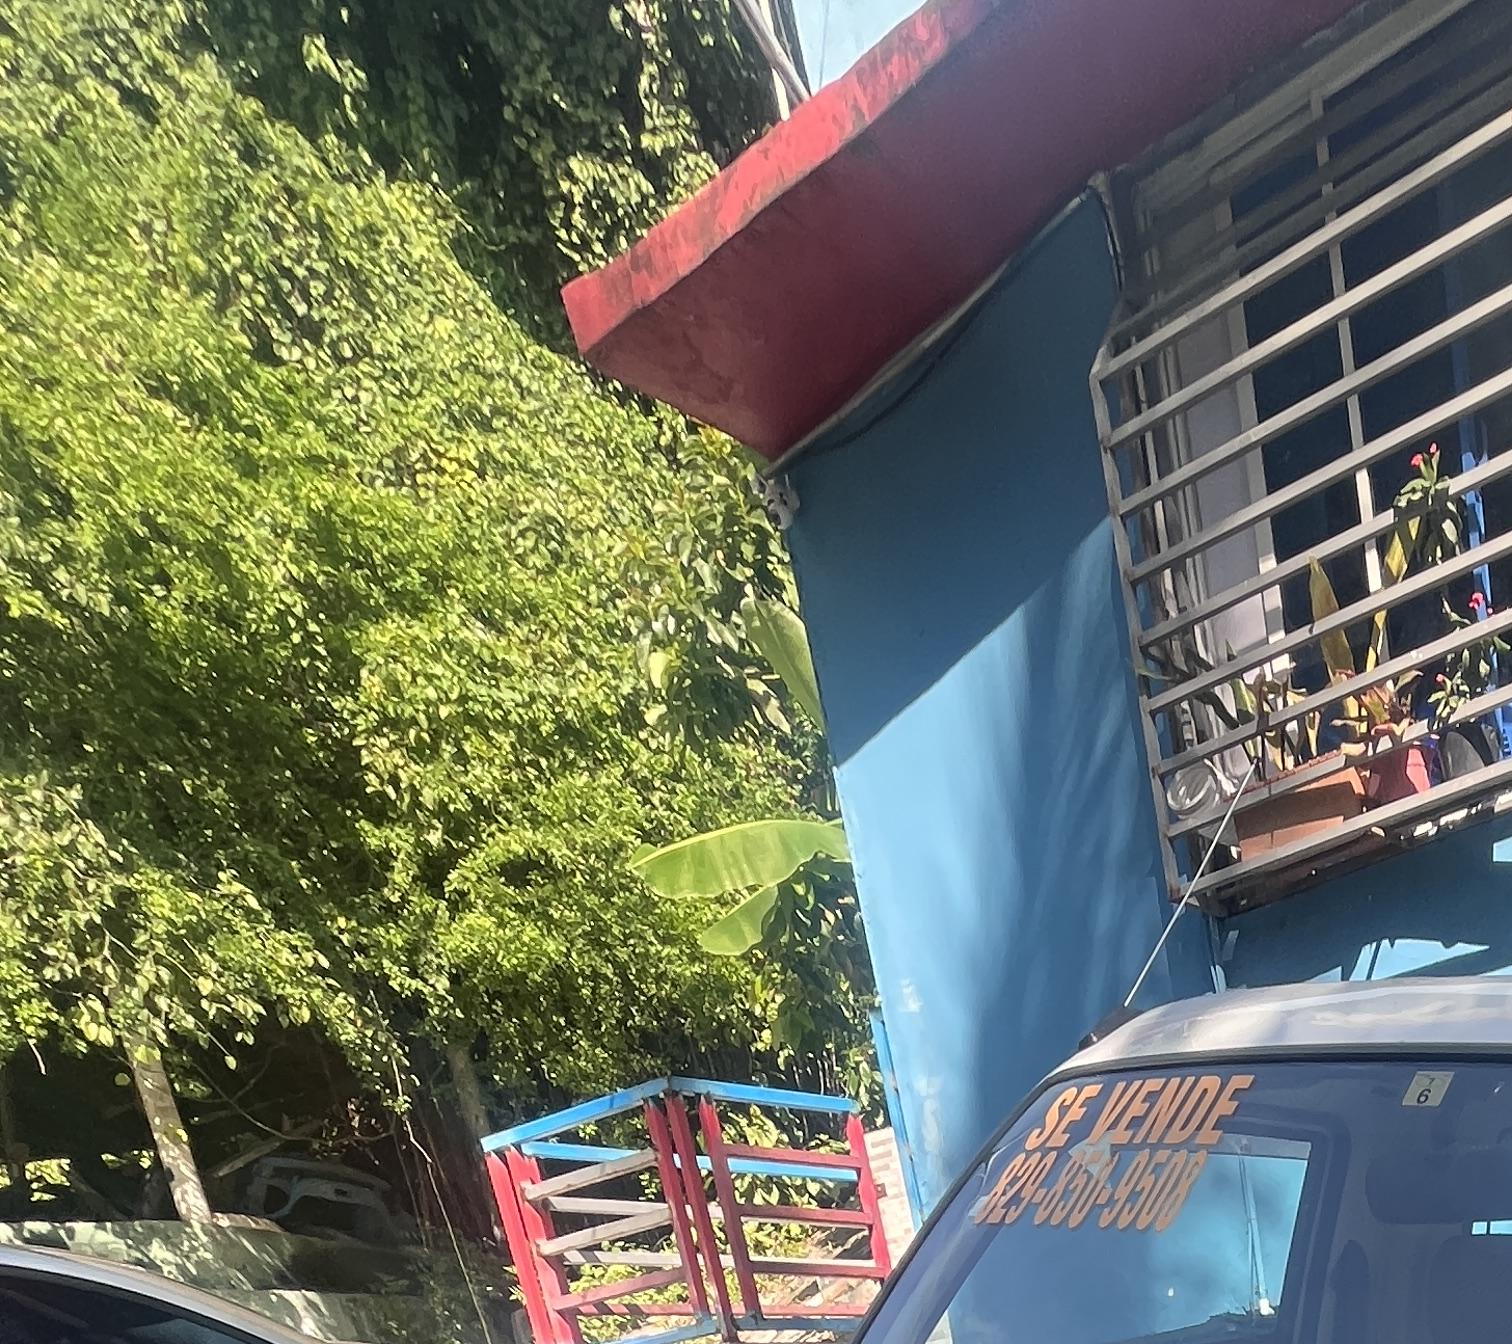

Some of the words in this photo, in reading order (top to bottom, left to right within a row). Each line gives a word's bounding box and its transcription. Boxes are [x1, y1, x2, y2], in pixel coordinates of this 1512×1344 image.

[1024, 1083, 1104, 1151] SE
[1087, 1074, 1255, 1145] VENDE
[1416, 1088, 1432, 1105] 6
